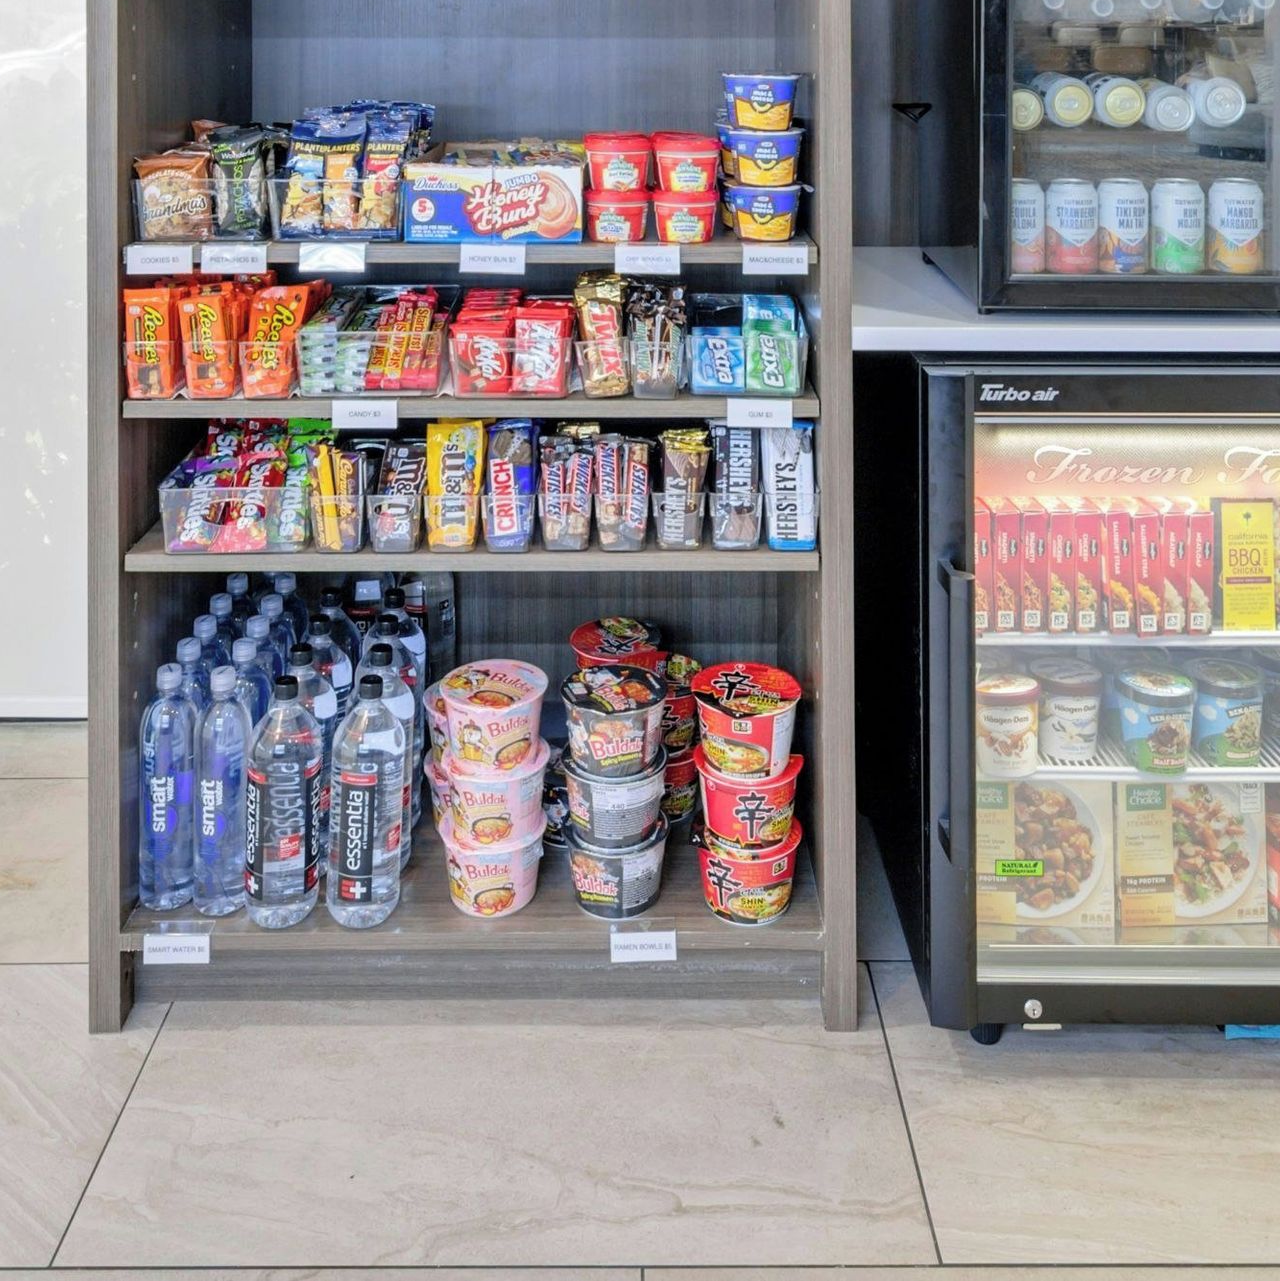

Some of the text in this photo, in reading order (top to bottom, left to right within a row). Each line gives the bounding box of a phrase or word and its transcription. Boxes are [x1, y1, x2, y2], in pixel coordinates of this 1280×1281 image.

[368, 142, 405, 152] PLANTERS
[414, 176, 459, 191] Duchess
[504, 173, 540, 188] JUMBO
[417, 201, 427, 213] 5
[467, 183, 545, 210] Honey
[473, 200, 537, 231] Buns
[1116, 207, 1131, 217] TIKI
[1118, 219, 1133, 229] MAI
[1183, 208, 1198, 218] RUM
[1227, 207, 1253, 217] MANGO
[748, 256, 795, 264] MAC&CHEESE
[143, 305, 165, 365] Reese's
[197, 303, 218, 363] Reese's
[261, 304, 294, 370] Reese's
[591, 304, 624, 377] TWIX
[707, 338, 734, 384] Extra
[759, 333, 785, 388] Extra
[979, 383, 1059, 401] Turbo air
[748, 410, 764, 418] GUM
[1026, 445, 1206, 485] Frozen
[180, 473, 217, 541] Skittles
[236, 463, 272, 530] Skittles
[493, 460, 516, 532] CRUNCH
[775, 462, 798, 541] HERSHEY'S
[1228, 548, 1261, 567] BBQ
[1232, 567, 1264, 575] CHICKEN
[712, 671, 760, 702] 辛
[590, 737, 644, 760] Buldak
[151, 777, 166, 833] smart
[201, 779, 215, 836] smart
[463, 791, 507, 807] Buldak
[1129, 794, 1162, 804] Choice
[247, 784, 257, 865] essentia
[734, 792, 775, 841] 辛
[346, 790, 363, 871] essentia
[466, 862, 510, 879] Buldak
[573, 871, 620, 896] Buldak
[706, 858, 743, 908] 辛
[1138, 877, 1166, 885] PROTEIN
[614, 943, 638, 951] RAMEN
